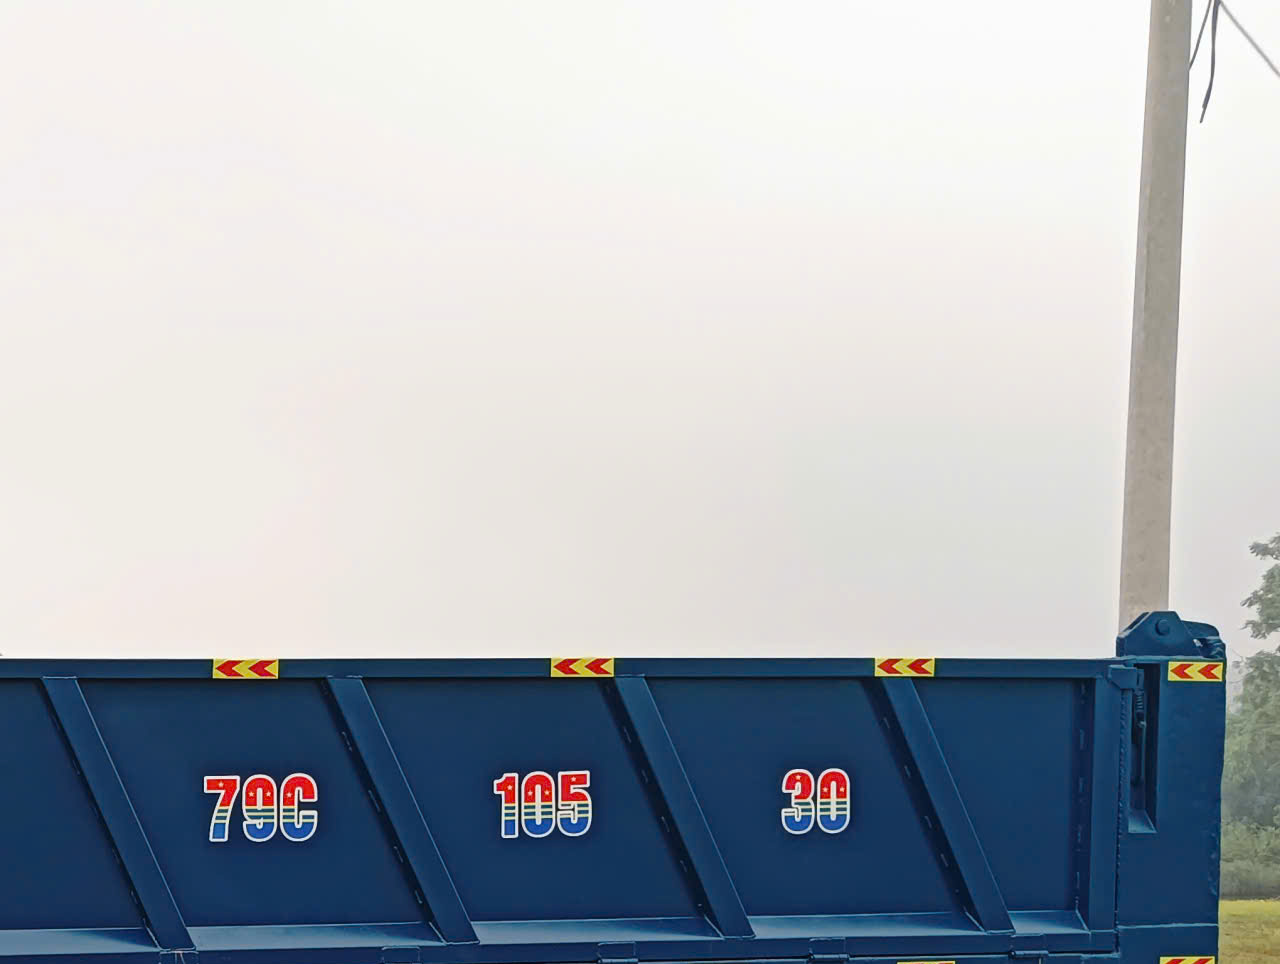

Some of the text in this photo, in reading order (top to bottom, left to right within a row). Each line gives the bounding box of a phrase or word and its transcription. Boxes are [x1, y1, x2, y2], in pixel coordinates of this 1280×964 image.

[204, 767, 852, 842] 79C 105 30
